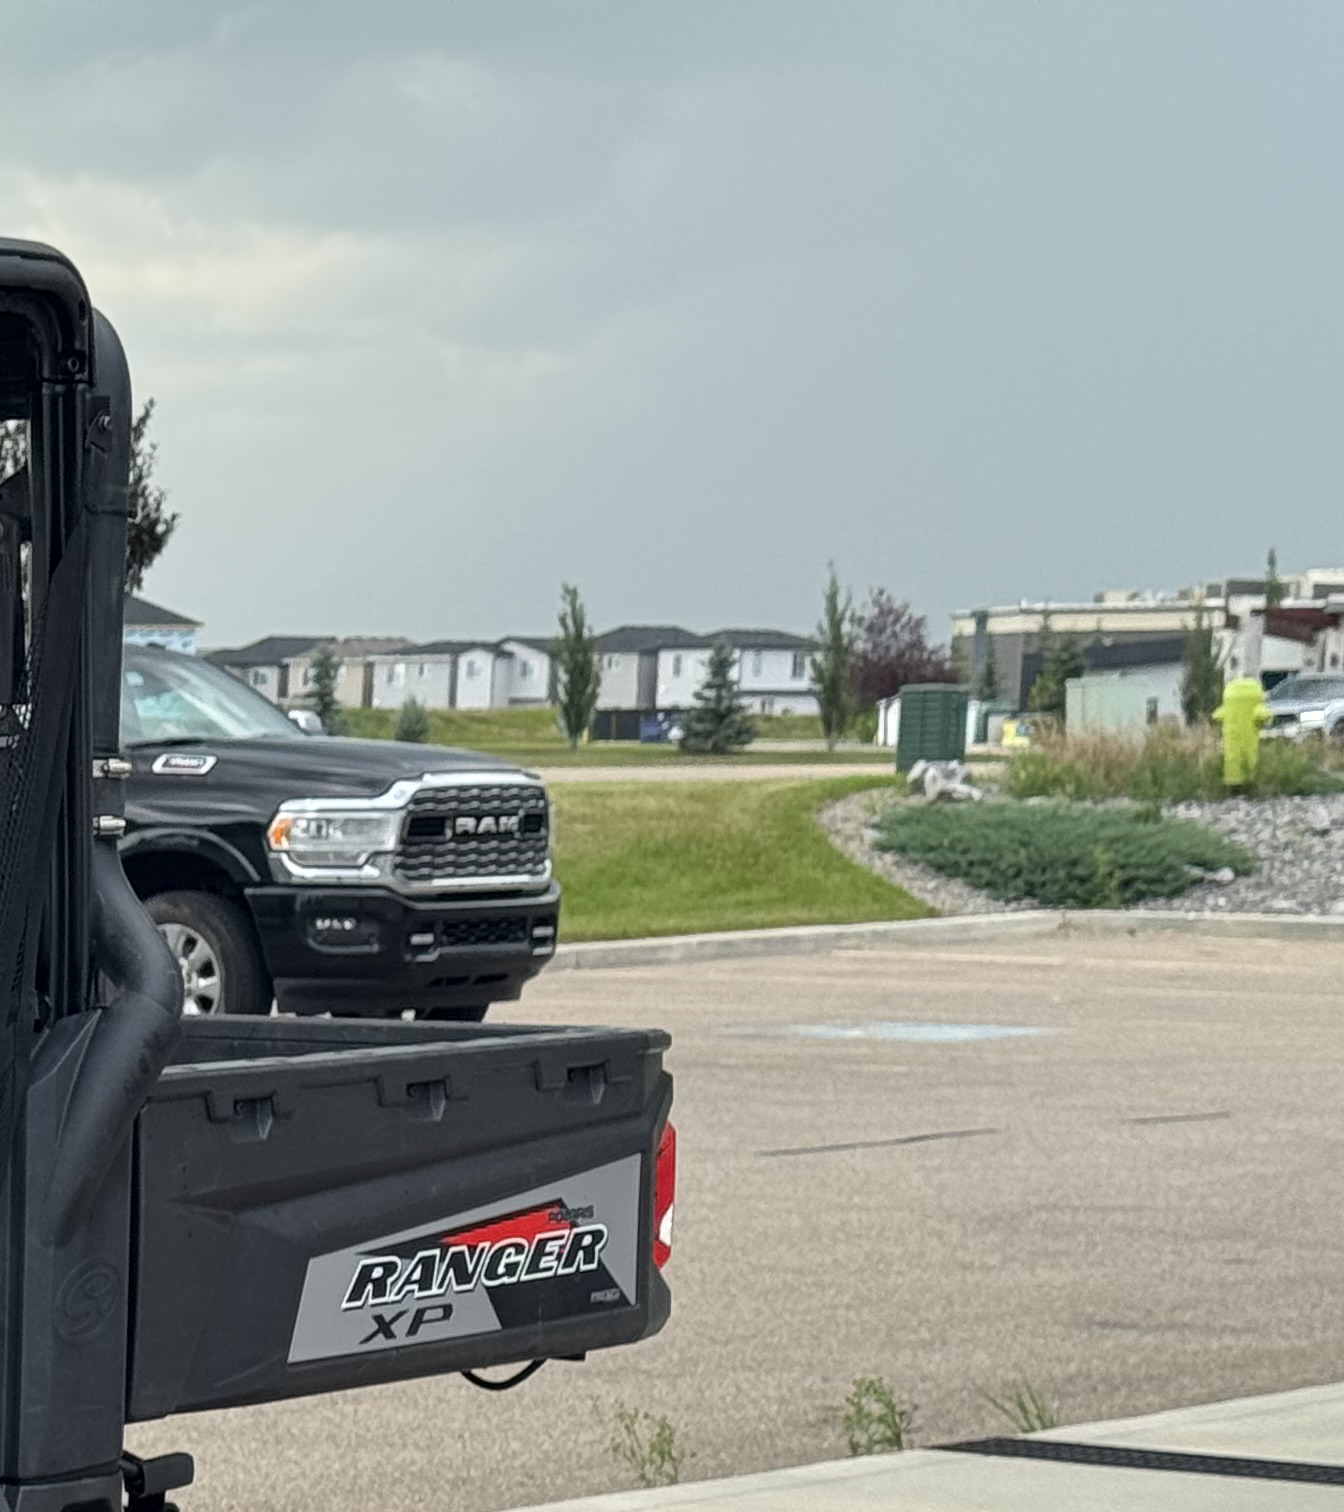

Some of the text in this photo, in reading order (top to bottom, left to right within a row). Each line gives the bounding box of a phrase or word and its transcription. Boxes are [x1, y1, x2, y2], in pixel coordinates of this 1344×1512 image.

[455, 815, 519, 835] RAM
[340, 1223, 609, 1312] RANGER
[359, 1303, 454, 1345] XP
